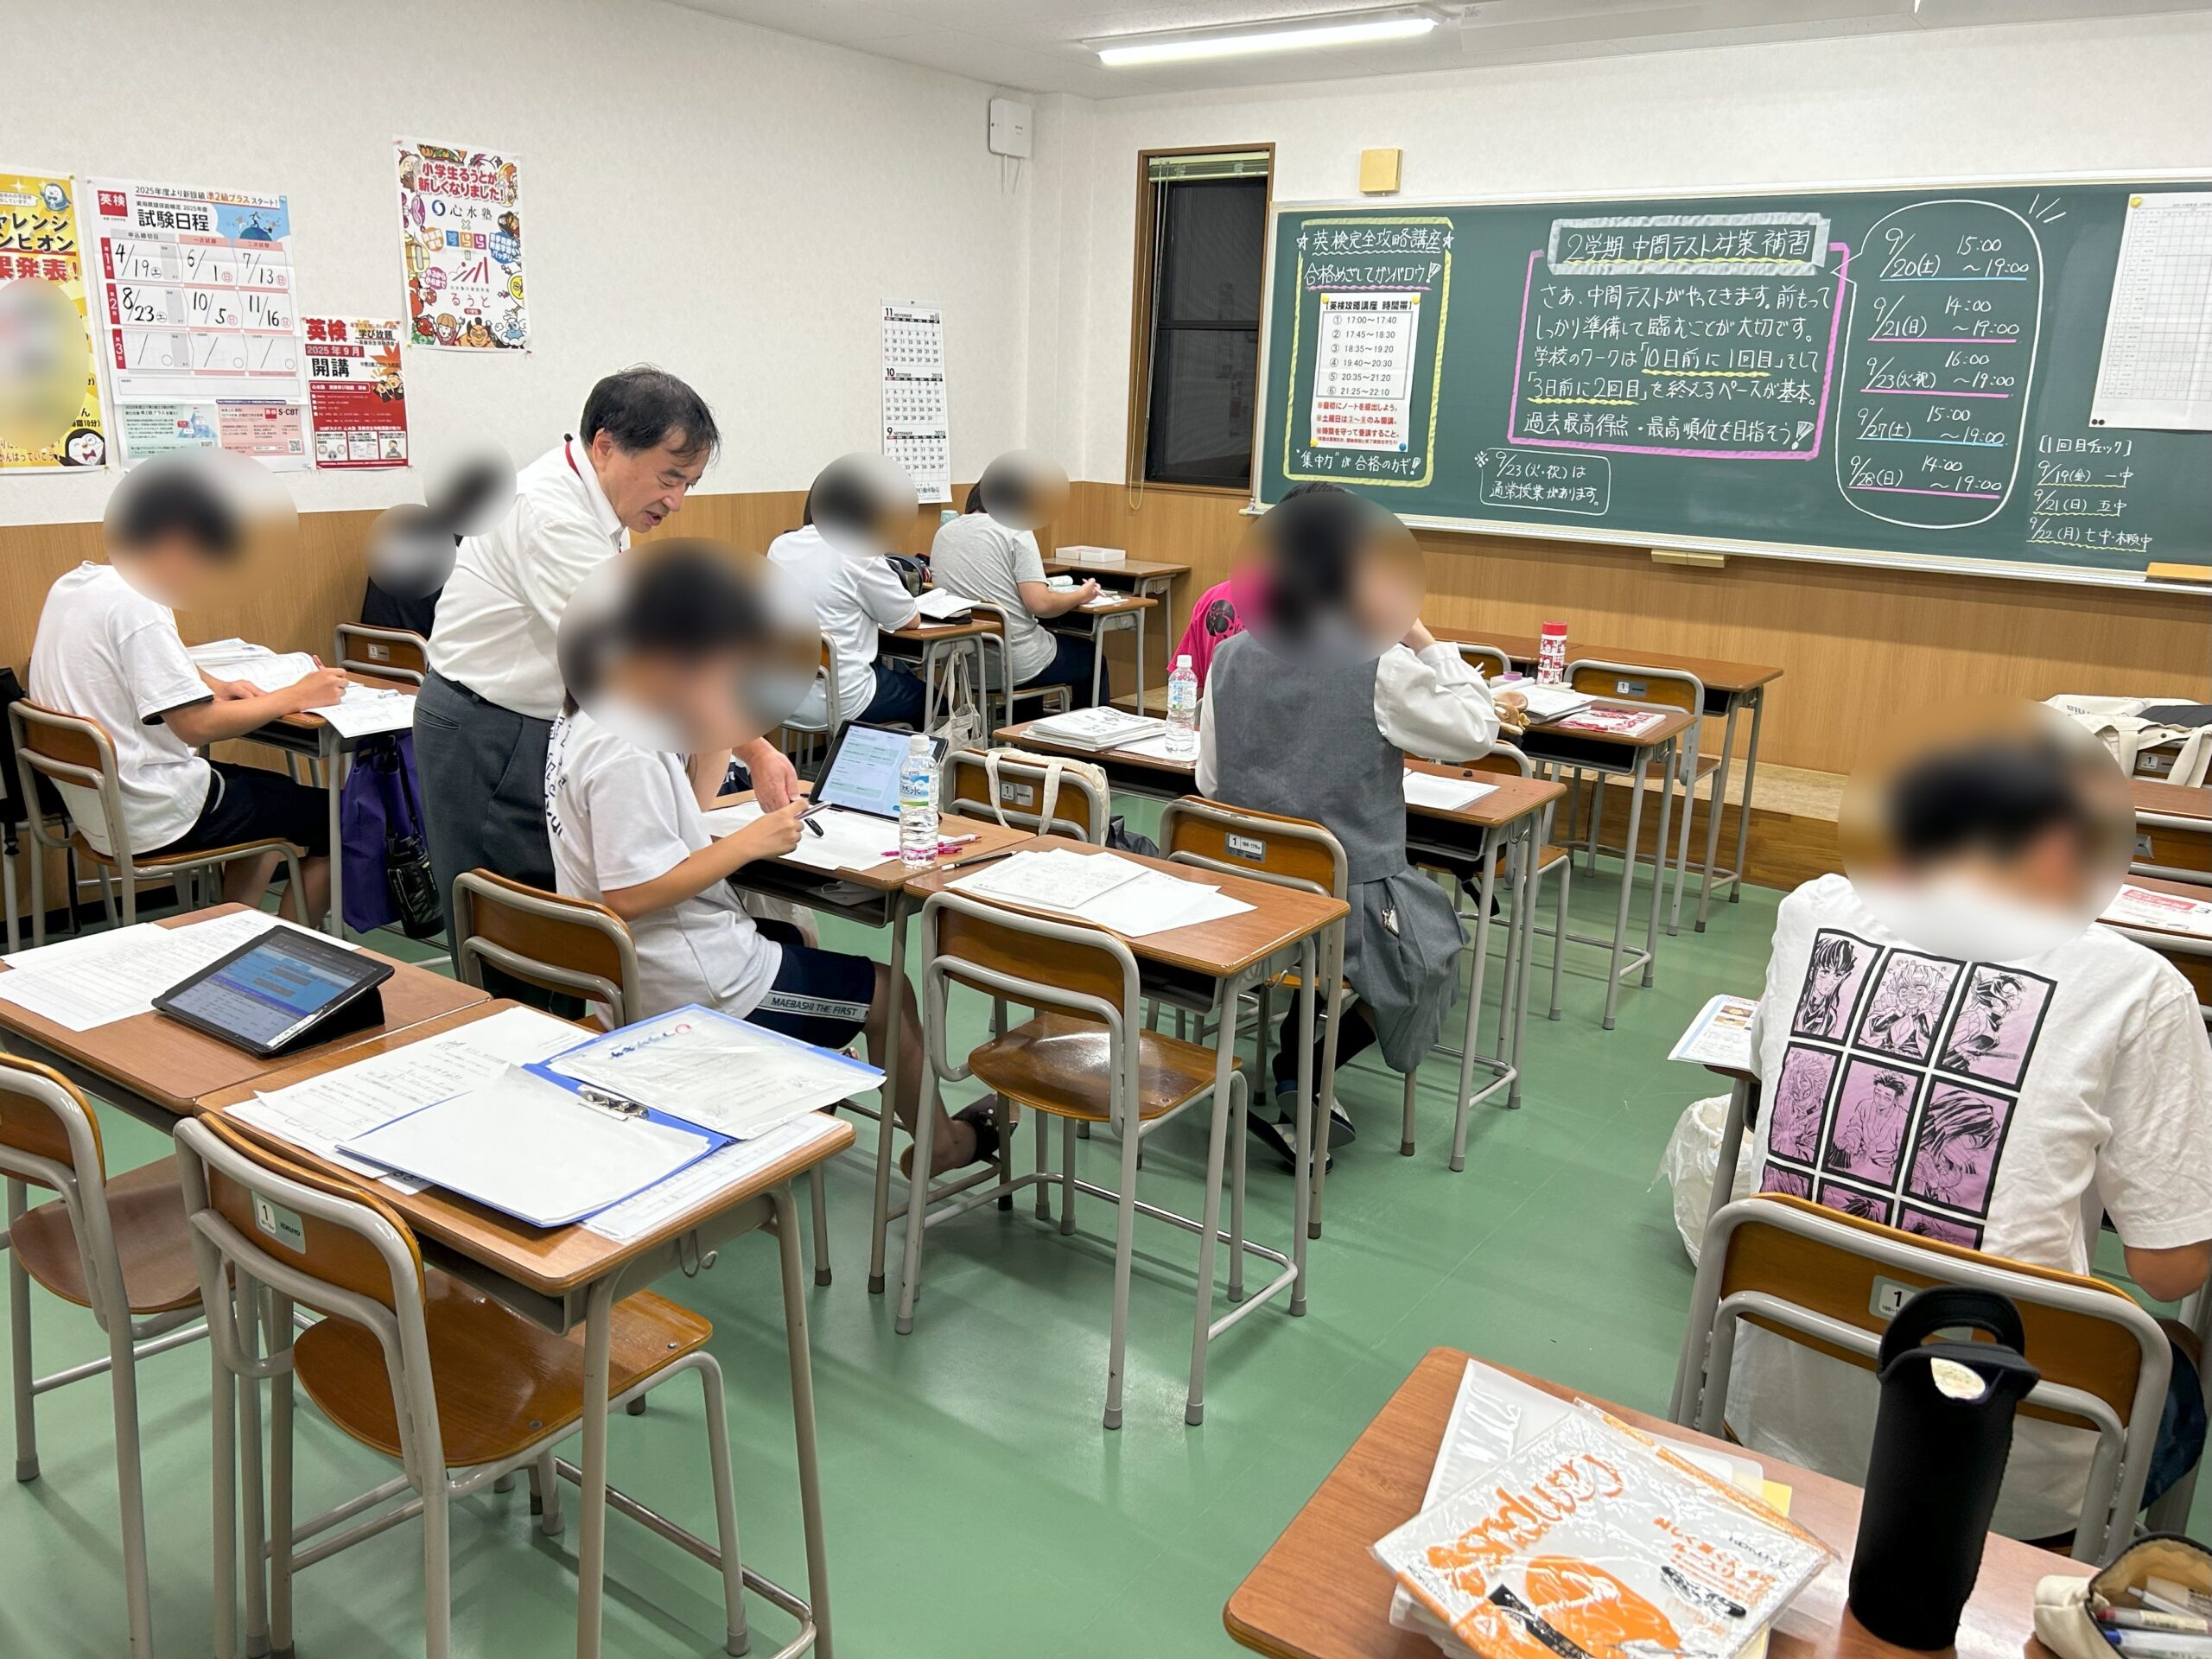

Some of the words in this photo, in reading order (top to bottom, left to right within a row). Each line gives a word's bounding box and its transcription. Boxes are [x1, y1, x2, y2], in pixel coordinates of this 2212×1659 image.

[422, 162, 498, 186] 小学生るうとが
[99, 194, 125, 207] 英検
[137, 210, 209, 232] 試験日程
[450, 205, 493, 220] 心水塾
[1313, 228, 1442, 251] 英検完全攻略講座
[1957, 235, 2001, 255] 15:00
[1945, 295, 1991, 315] 14:00
[306, 318, 347, 342] 英検
[312, 358, 349, 377] 開講
[1945, 351, 1989, 367] 16:00
[887, 368, 894, 377] 10
[1927, 405, 1970, 422] 15:00
[1922, 455, 1962, 472] 14:00
[1232, 837, 1236, 846] 1
[772, 997, 814, 1010] MAEBASHI
[816, 1004, 831, 1013] THE
[833, 1006, 857, 1016] FIRST
[263, 1205, 268, 1221] 1
[1894, 1291, 1903, 1307] 1
